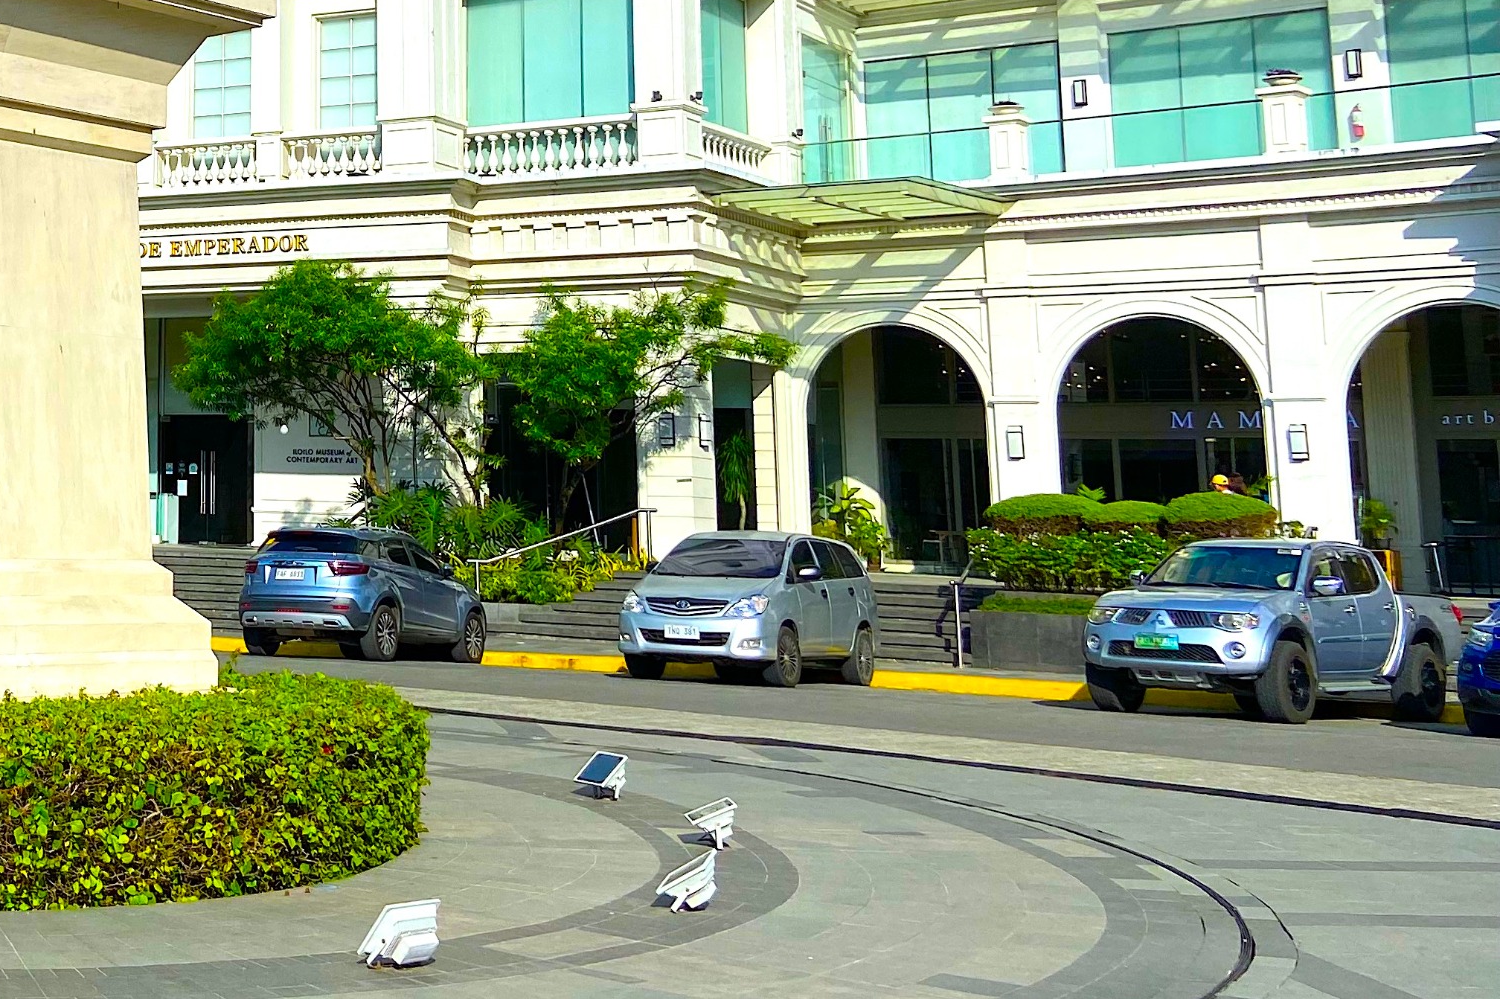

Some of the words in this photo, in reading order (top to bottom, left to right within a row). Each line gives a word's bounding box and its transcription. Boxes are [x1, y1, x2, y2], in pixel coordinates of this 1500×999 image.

[169, 234, 310, 258] EMPERADOR
[1441, 414, 1474, 425] art
[286, 456, 343, 464] CONTEMPORARY
